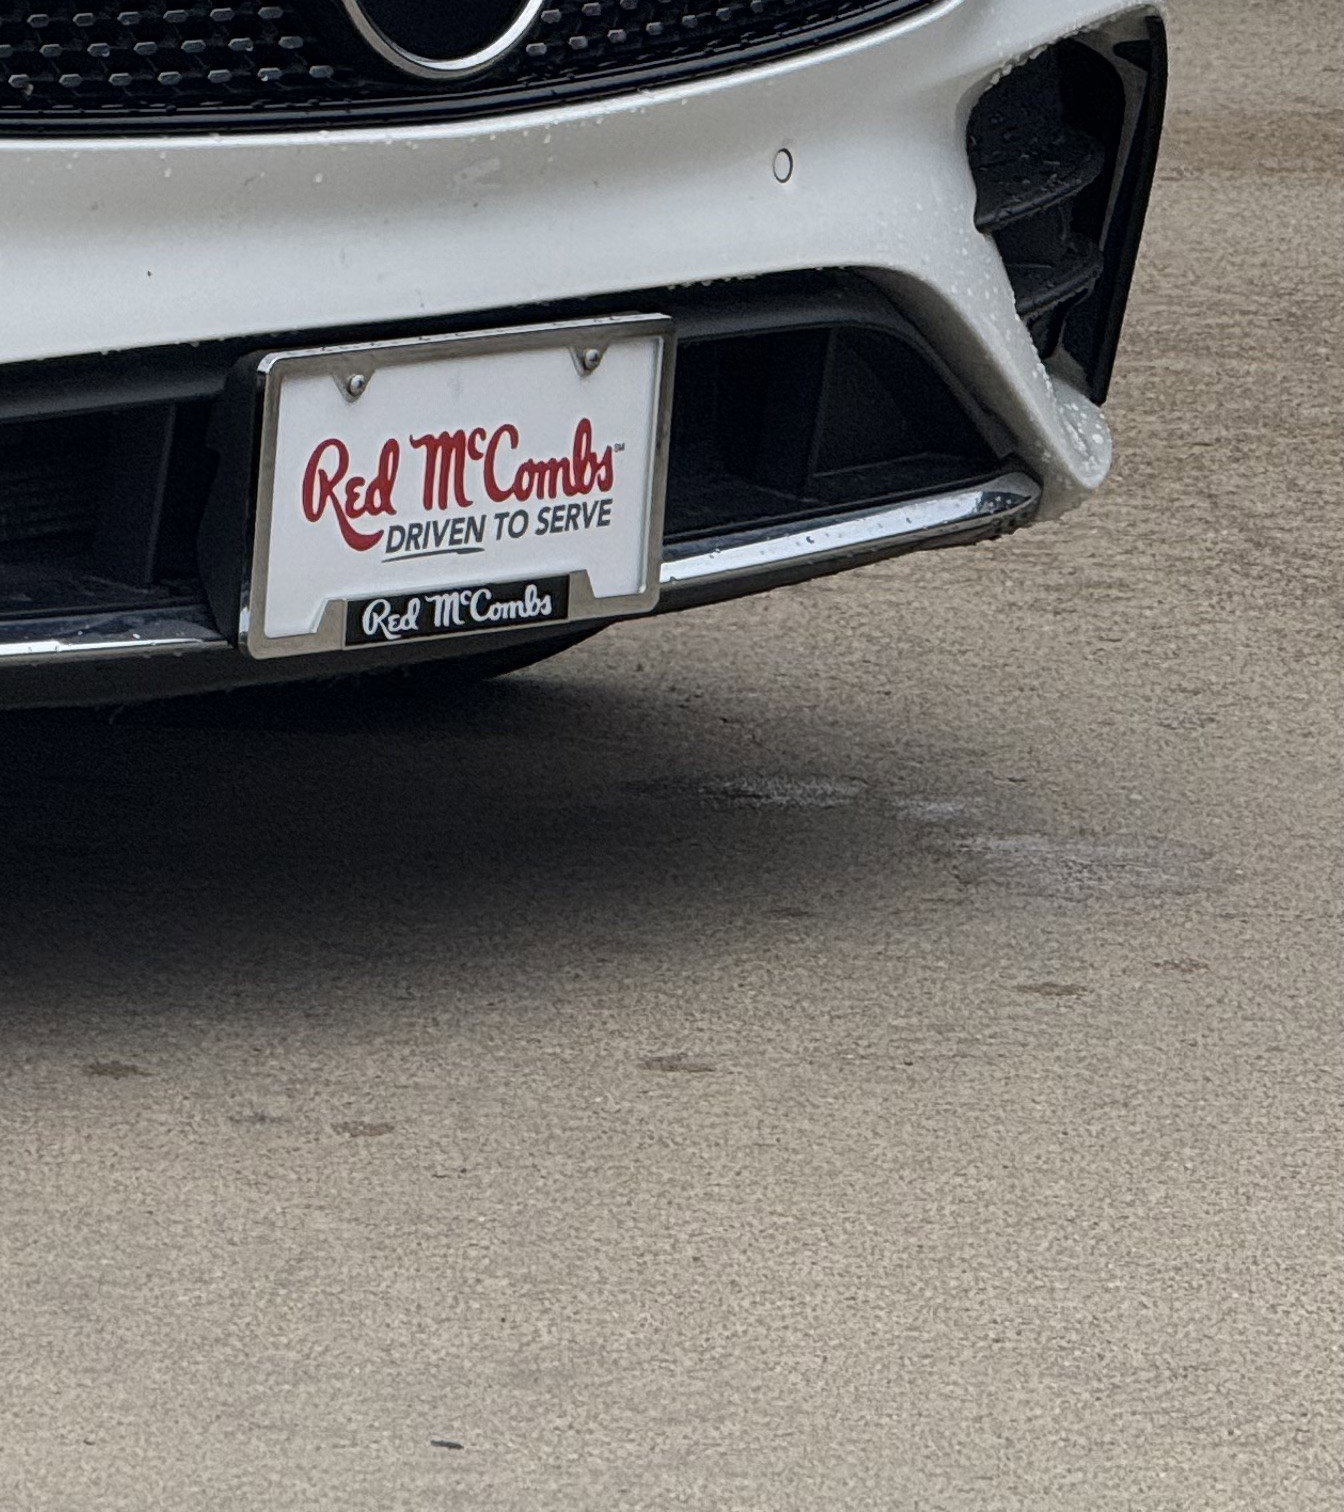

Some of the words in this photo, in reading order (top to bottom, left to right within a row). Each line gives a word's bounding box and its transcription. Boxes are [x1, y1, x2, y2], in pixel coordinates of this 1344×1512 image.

[302, 438, 399, 551] Red
[410, 418, 613, 510] McCombs
[385, 515, 486, 553] DRIVEN
[494, 509, 529, 541] TO
[534, 498, 613, 536] SERVE
[362, 598, 418, 640] Red
[426, 585, 552, 627] McCombs
